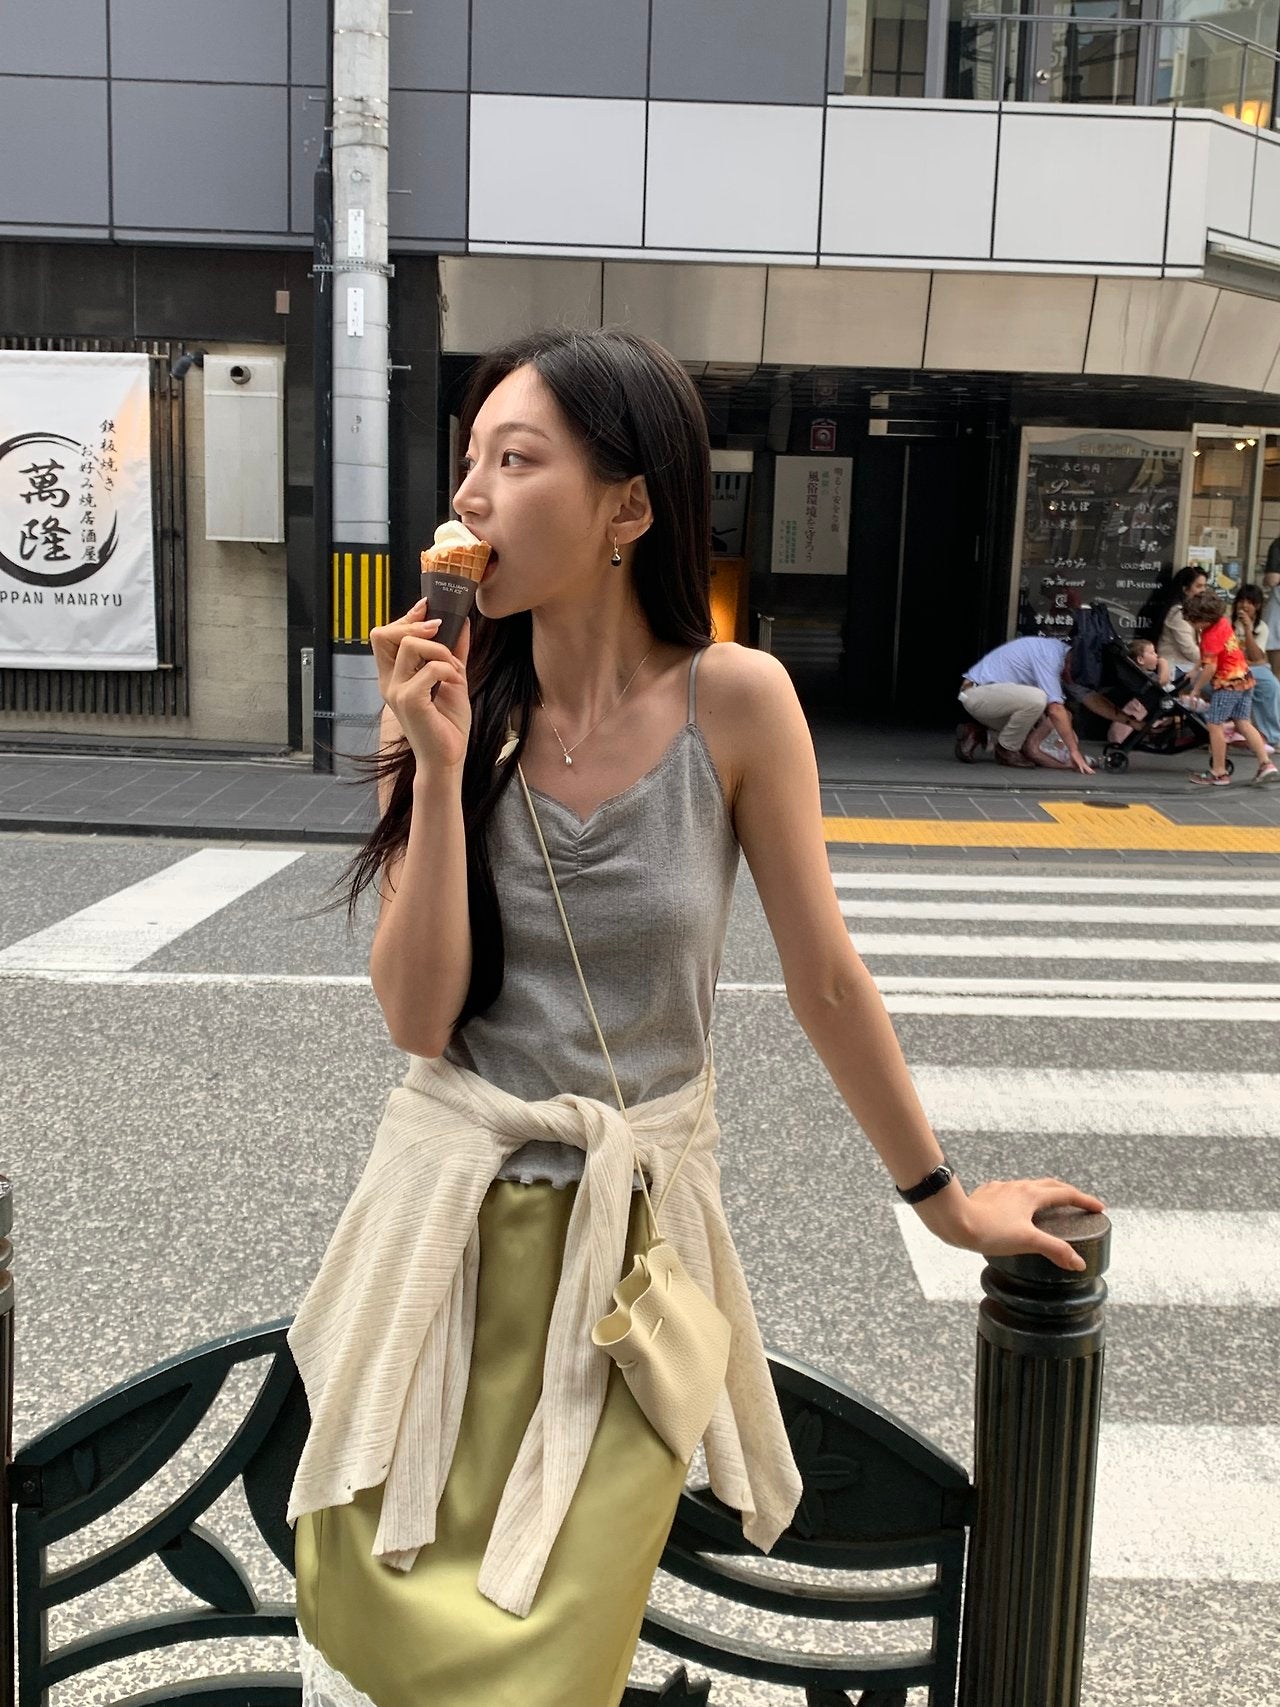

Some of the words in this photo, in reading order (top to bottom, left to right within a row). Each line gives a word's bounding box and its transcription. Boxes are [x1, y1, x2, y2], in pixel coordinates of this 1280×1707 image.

[99, 419, 118, 492] 鉄板焼き
[18, 459, 72, 562] 萬隆
[79, 444, 97, 562] お好み焼居酒屋
[0, 590, 43, 605] PPAN
[54, 592, 122, 607] MANRYU
